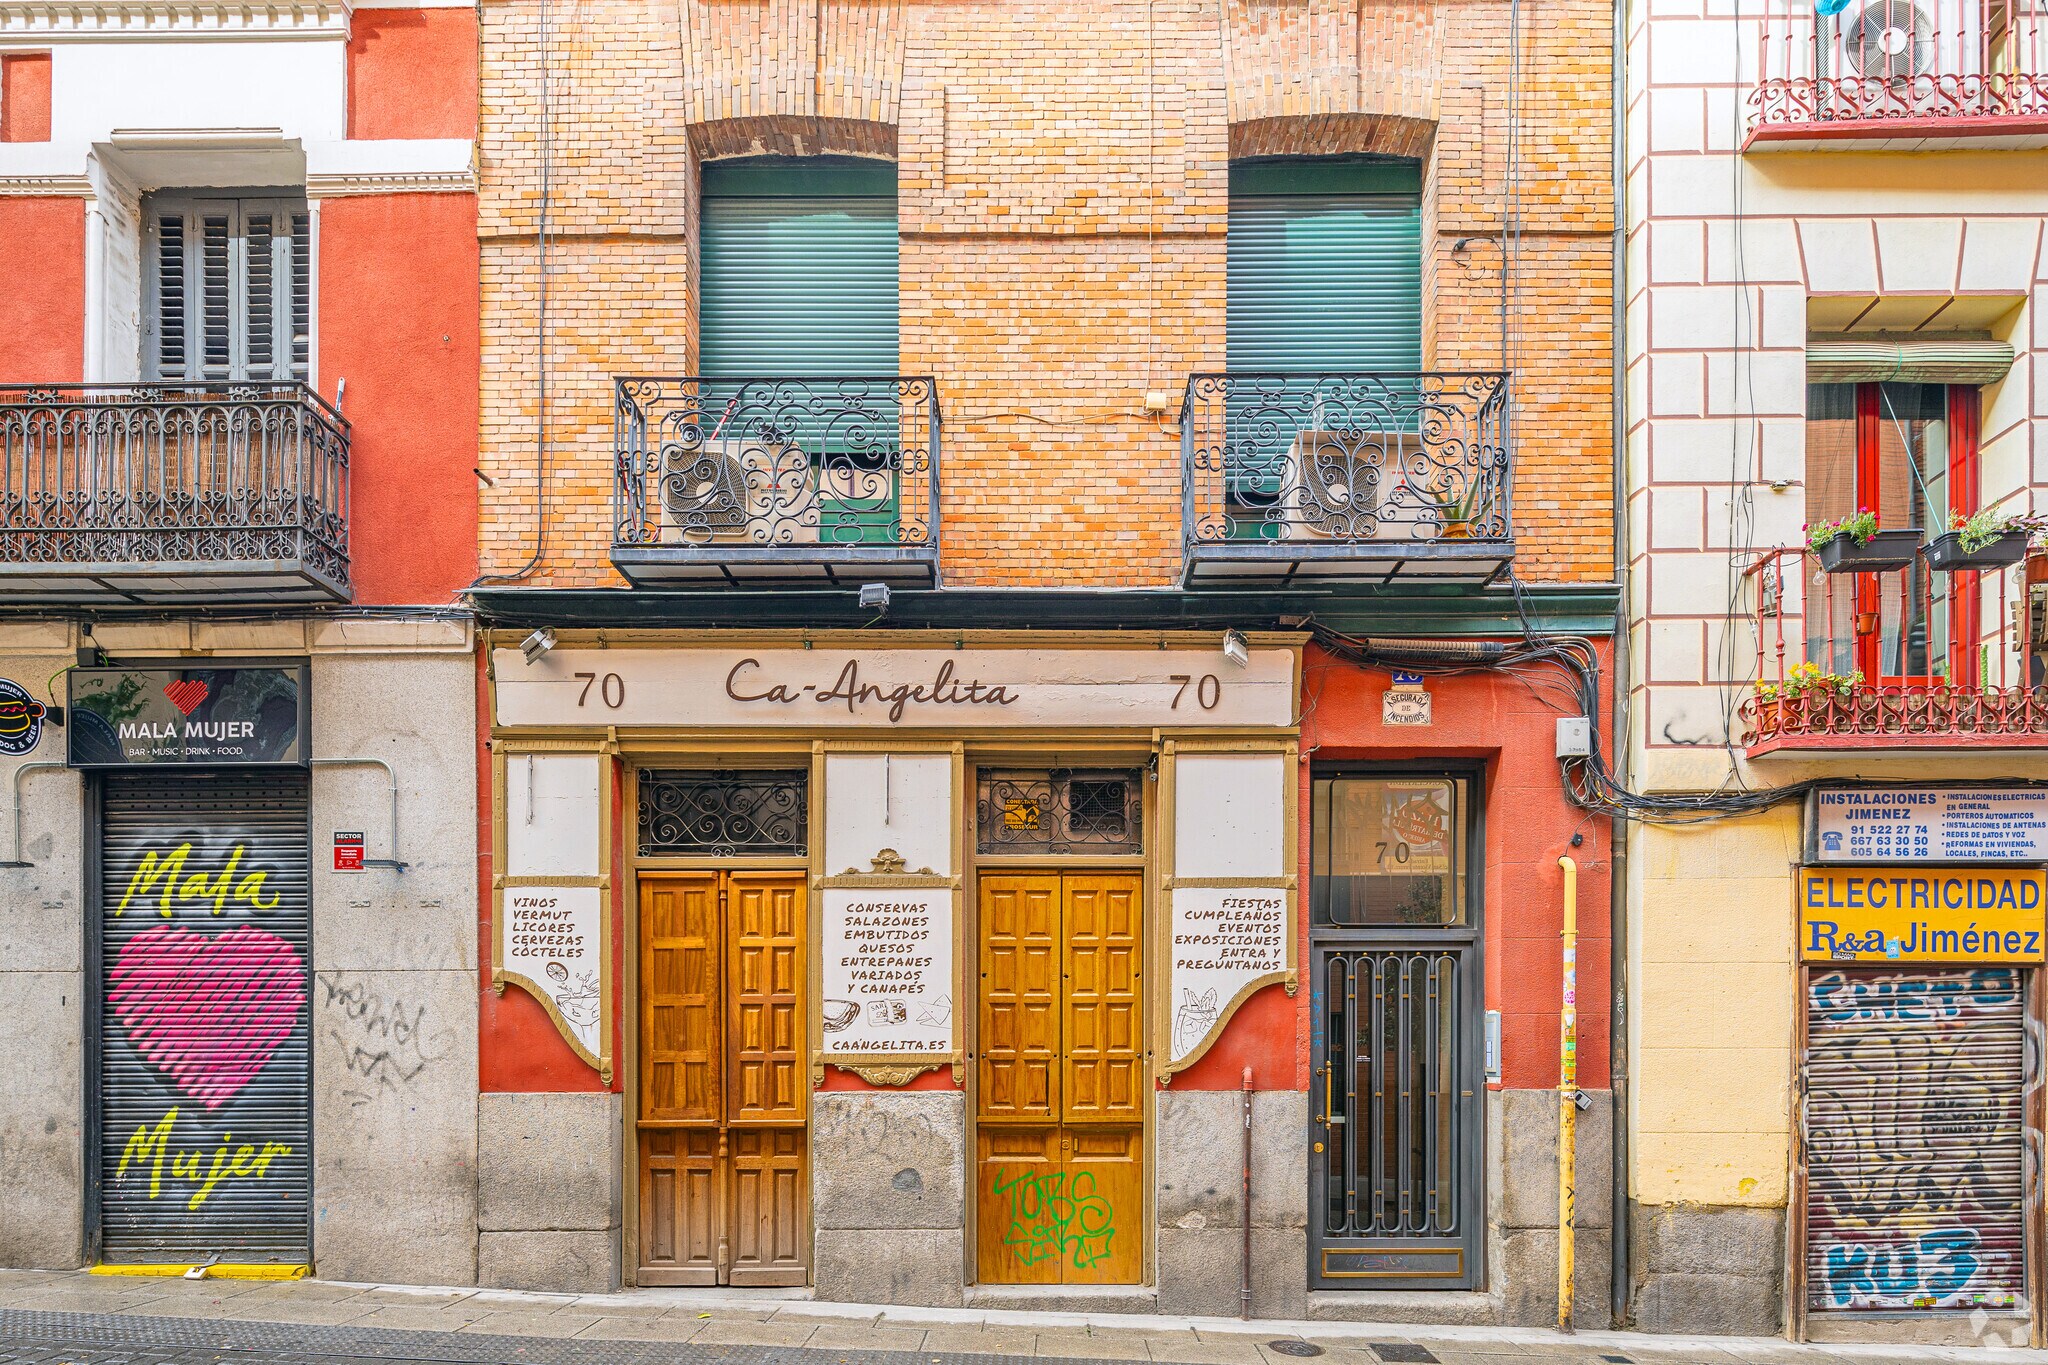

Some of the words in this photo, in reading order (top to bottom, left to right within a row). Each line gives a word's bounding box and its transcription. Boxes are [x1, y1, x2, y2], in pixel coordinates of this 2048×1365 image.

[574, 672, 625, 709] 70
[726, 658, 1019, 723] Ca-Angelita
[1169, 674, 1221, 710] 70
[1387, 694, 1427, 708] ASEGURADA
[1388, 712, 1424, 723] INCENDIOS
[26, 724, 37, 744] BEER
[118, 722, 177, 738] MALA
[185, 722, 255, 741] MUJER
[129, 748, 145, 756] BAR
[152, 748, 178, 756] MUSIC
[217, 747, 242, 755] FOOD
[1821, 793, 1937, 804] INSTALACIONES
[1846, 808, 1911, 820] JIMENEZ
[1985, 812, 2034, 820] AUTOMATICOS
[1851, 826, 1864, 834] 91
[1870, 826, 1892, 834] 522
[1896, 826, 1910, 834] 27
[1914, 826, 1928, 834] 74
[1850, 836, 1872, 846] 667
[1876, 836, 1891, 846] 63
[1896, 836, 1910, 846] 30
[1914, 836, 1928, 846] 50
[1375, 842, 1410, 864] 70
[1850, 848, 1872, 856] 605
[1876, 848, 1891, 856] 64
[1896, 848, 1910, 856] 56
[1914, 848, 1928, 856] 26
[1946, 850, 1978, 858] LOCALES,
[1980, 850, 2008, 858] FINCAS,
[115, 842, 280, 918] Mala
[1808, 878, 2040, 909] ELECTRICIDAD
[514, 898, 558, 908] VINOS
[846, 903, 928, 913] CONSERVAS
[1222, 898, 1282, 908] FIESTAS
[513, 910, 572, 920] VERMUT
[1185, 908, 1282, 920] CUMPLEAÑOS
[844, 916, 929, 926] SALAZONES
[512, 922, 576, 933] LICORES
[1218, 923, 1282, 934] EVENTOS
[512, 934, 584, 946] CERVEZAS
[844, 930, 929, 940] EMBUTIDOS
[1174, 935, 1282, 946] EXPOSICIONES
[1807, 921, 1887, 952] R&a
[1900, 922, 2040, 954] Jiménez
[512, 944, 584, 958] CÓCTELES
[858, 944, 914, 954] QUESOS
[1220, 948, 1267, 958] ENTRA
[1273, 948, 1281, 958] Y
[840, 956, 932, 967] ENTREPANES
[1176, 956, 1281, 970] PREGÚNTANOS
[851, 970, 922, 980] VARIADOS
[847, 984, 855, 994] Y
[860, 981, 926, 994] CANAPÉS
[116, 1105, 292, 1211] Mujer
